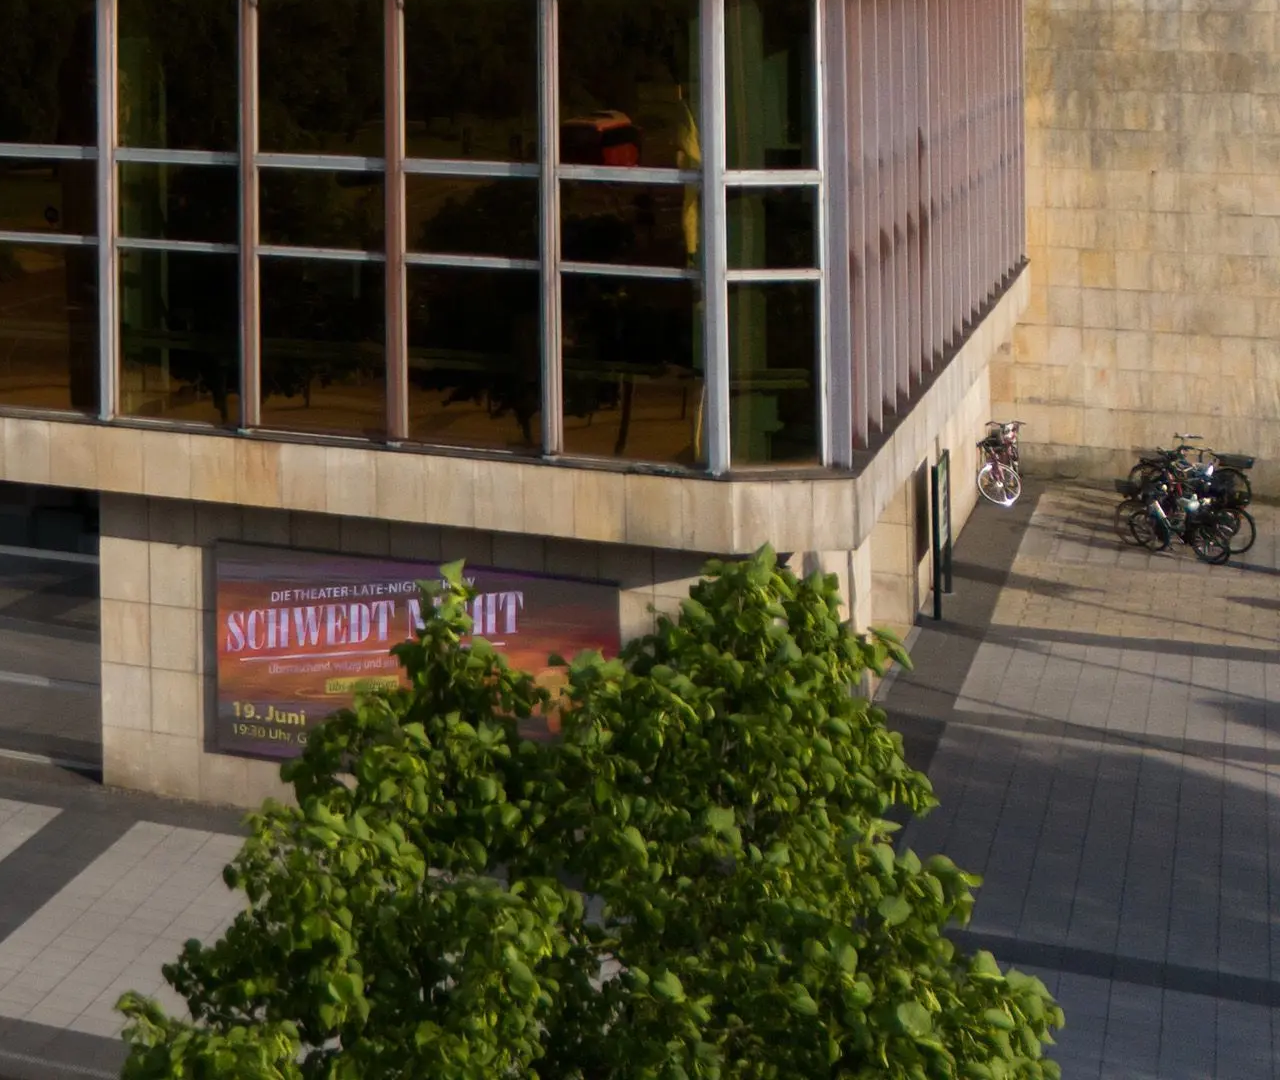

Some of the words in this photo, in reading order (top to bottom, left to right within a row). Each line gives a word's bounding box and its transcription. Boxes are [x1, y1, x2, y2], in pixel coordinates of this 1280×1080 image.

[271, 589, 291, 602] DIE
[226, 599, 396, 652] SCHWEDT
[232, 701, 262, 719] 19.
[265, 704, 306, 726] Juni
